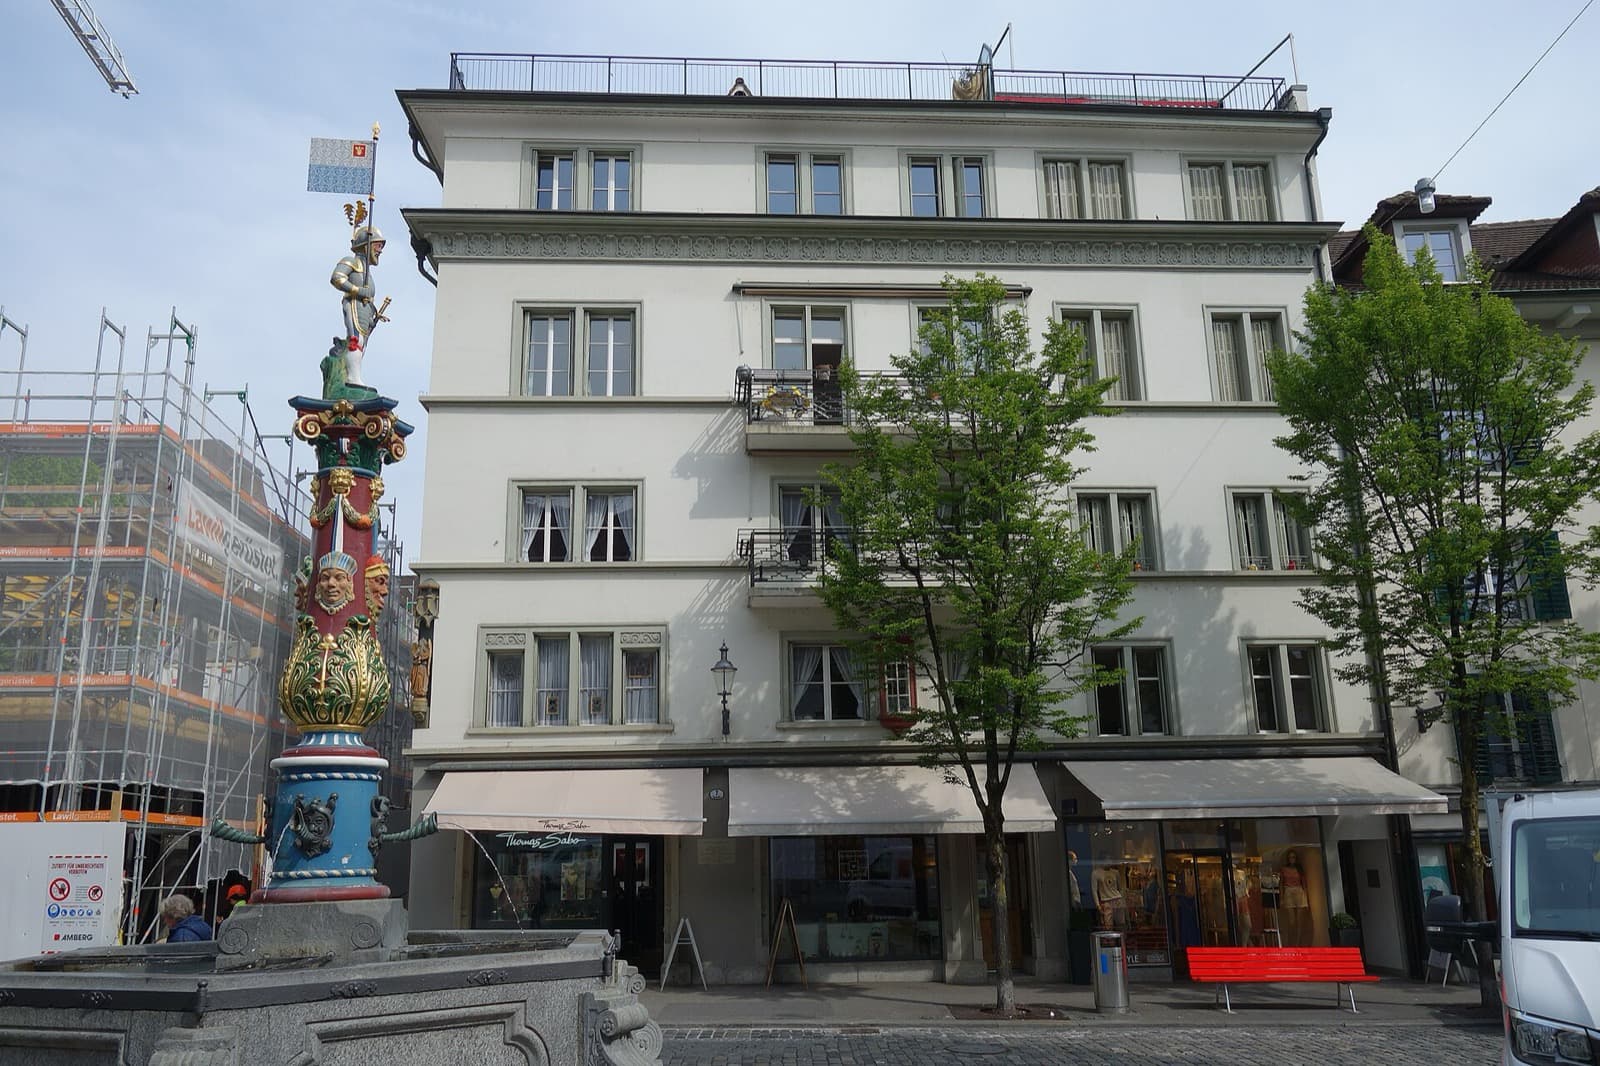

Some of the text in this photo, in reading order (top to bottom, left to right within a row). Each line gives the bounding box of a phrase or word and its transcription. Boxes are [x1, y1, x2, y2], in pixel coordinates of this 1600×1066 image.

[538, 819, 591, 830] Thomas Sabo
[495, 831, 587, 849] Thomas Sabo
[61, 933, 93, 941] AMBERG
